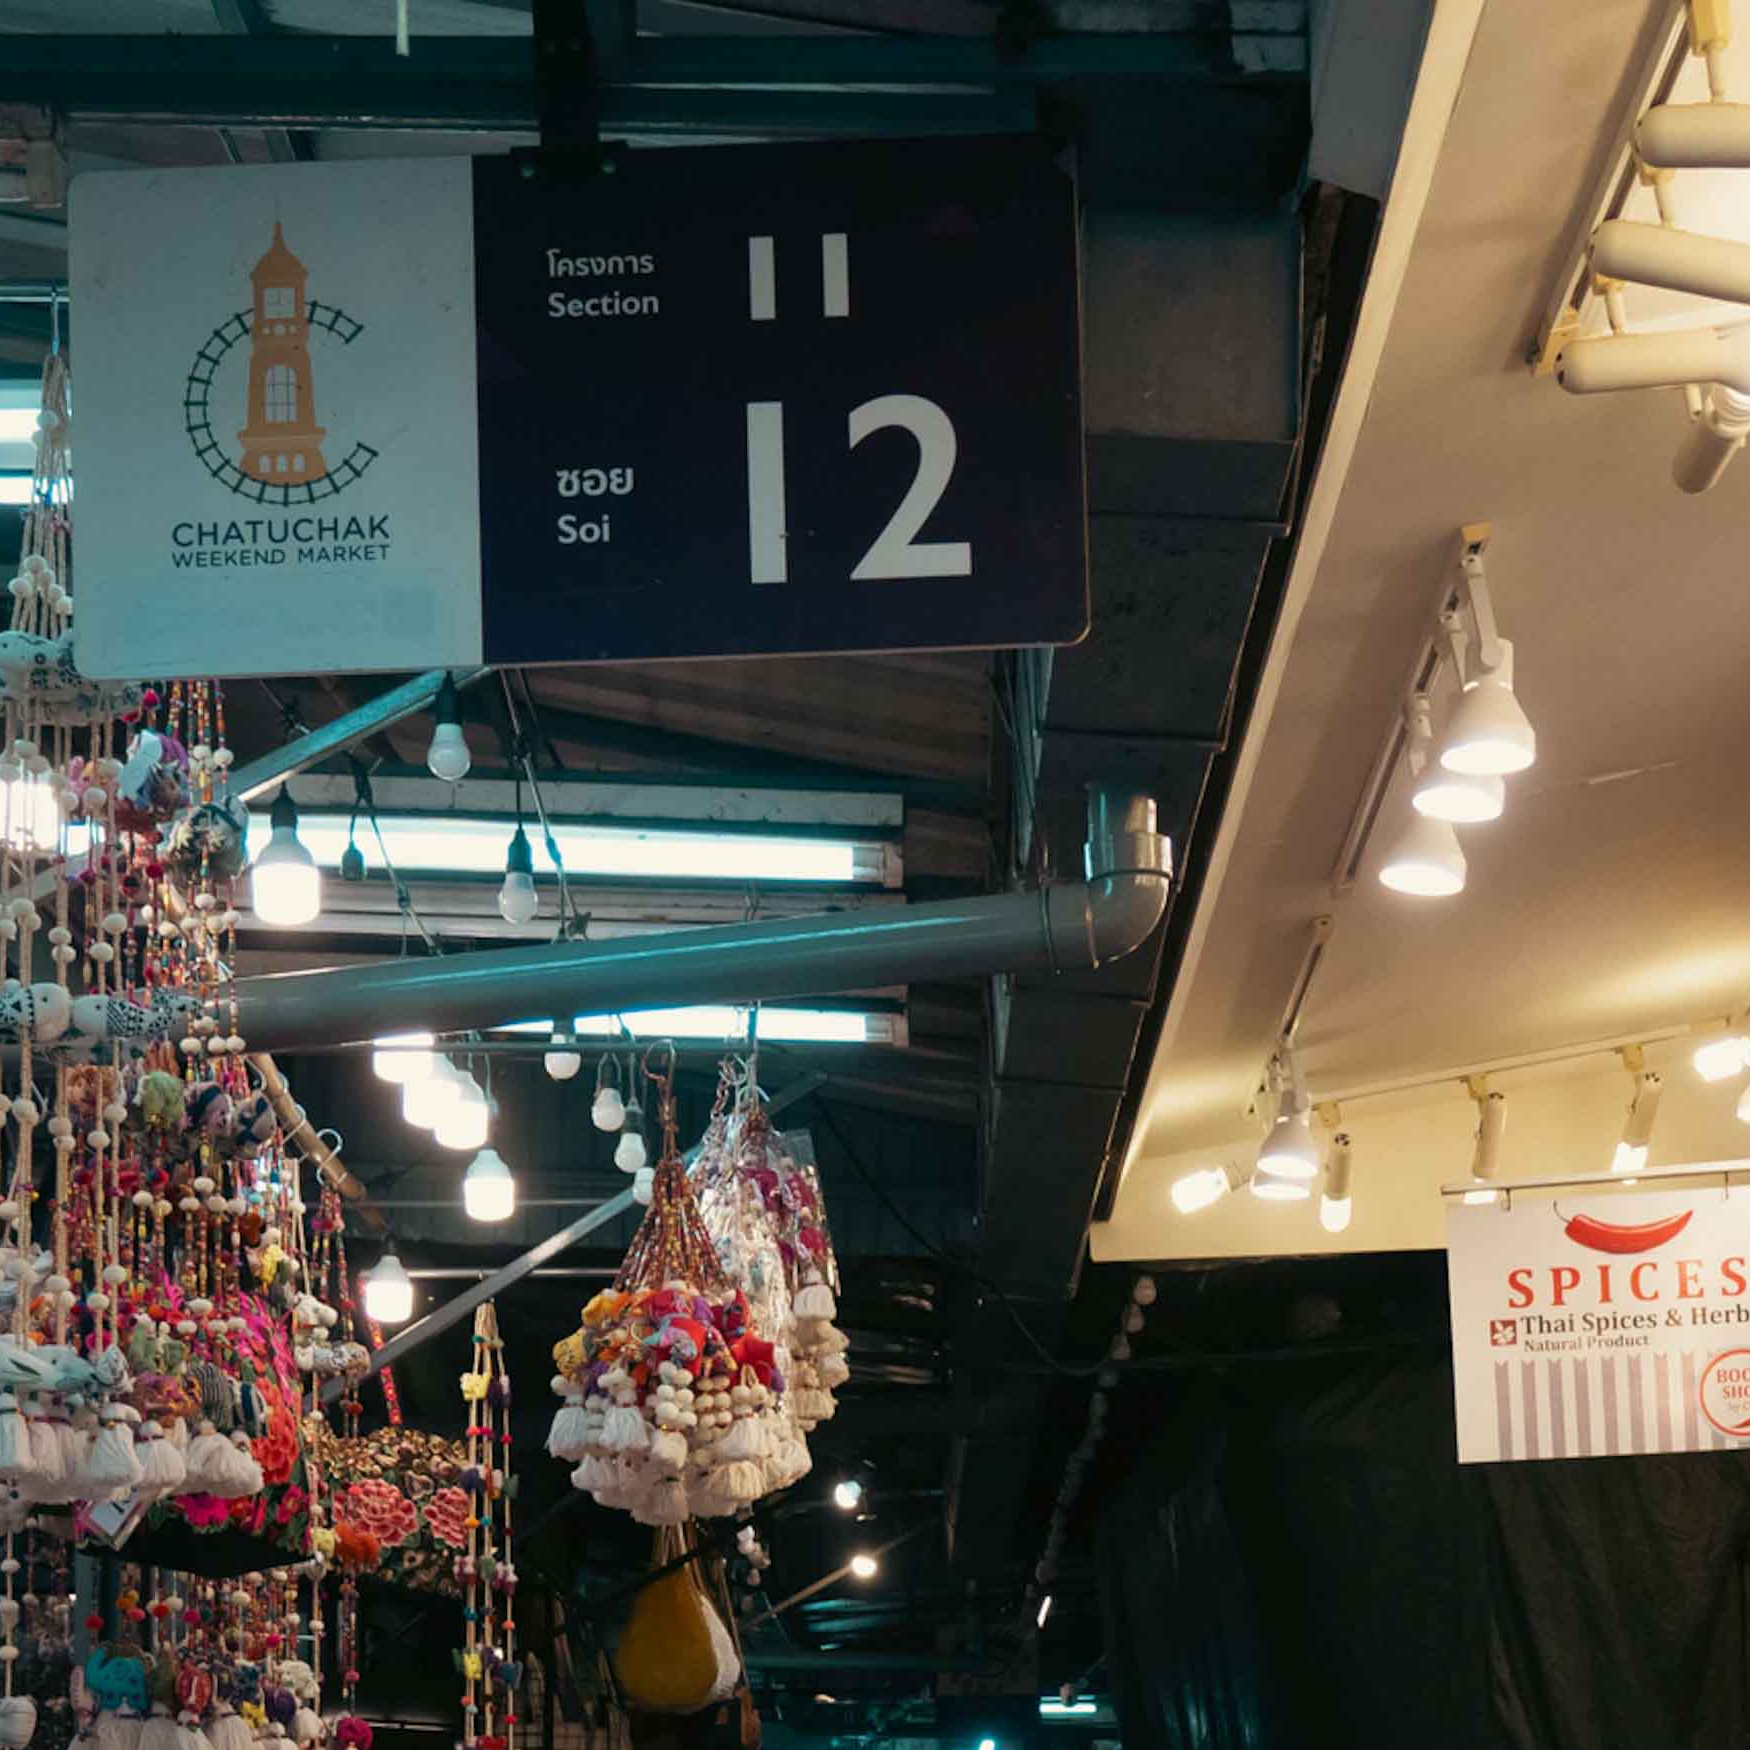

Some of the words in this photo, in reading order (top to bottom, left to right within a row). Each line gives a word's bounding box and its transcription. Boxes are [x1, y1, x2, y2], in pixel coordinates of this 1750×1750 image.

[546, 248, 655, 279] โครงการ
[748, 232, 851, 322] 11
[548, 289, 660, 318] Section
[555, 467, 634, 497] ซอย
[745, 394, 974, 584] 12
[171, 513, 391, 548] CHATUCHAK
[556, 513, 611, 545] Soi
[171, 549, 286, 569] WEEKEND
[296, 543, 391, 564] MARKET
[1507, 1256, 1748, 1309] SPICES
[1520, 1311, 1575, 1337] Thai
[1582, 1309, 1659, 1333] Spices
[1665, 1310, 1683, 1328] &
[1524, 1338, 1583, 1354] Natural
[1587, 1333, 1651, 1351] Product
